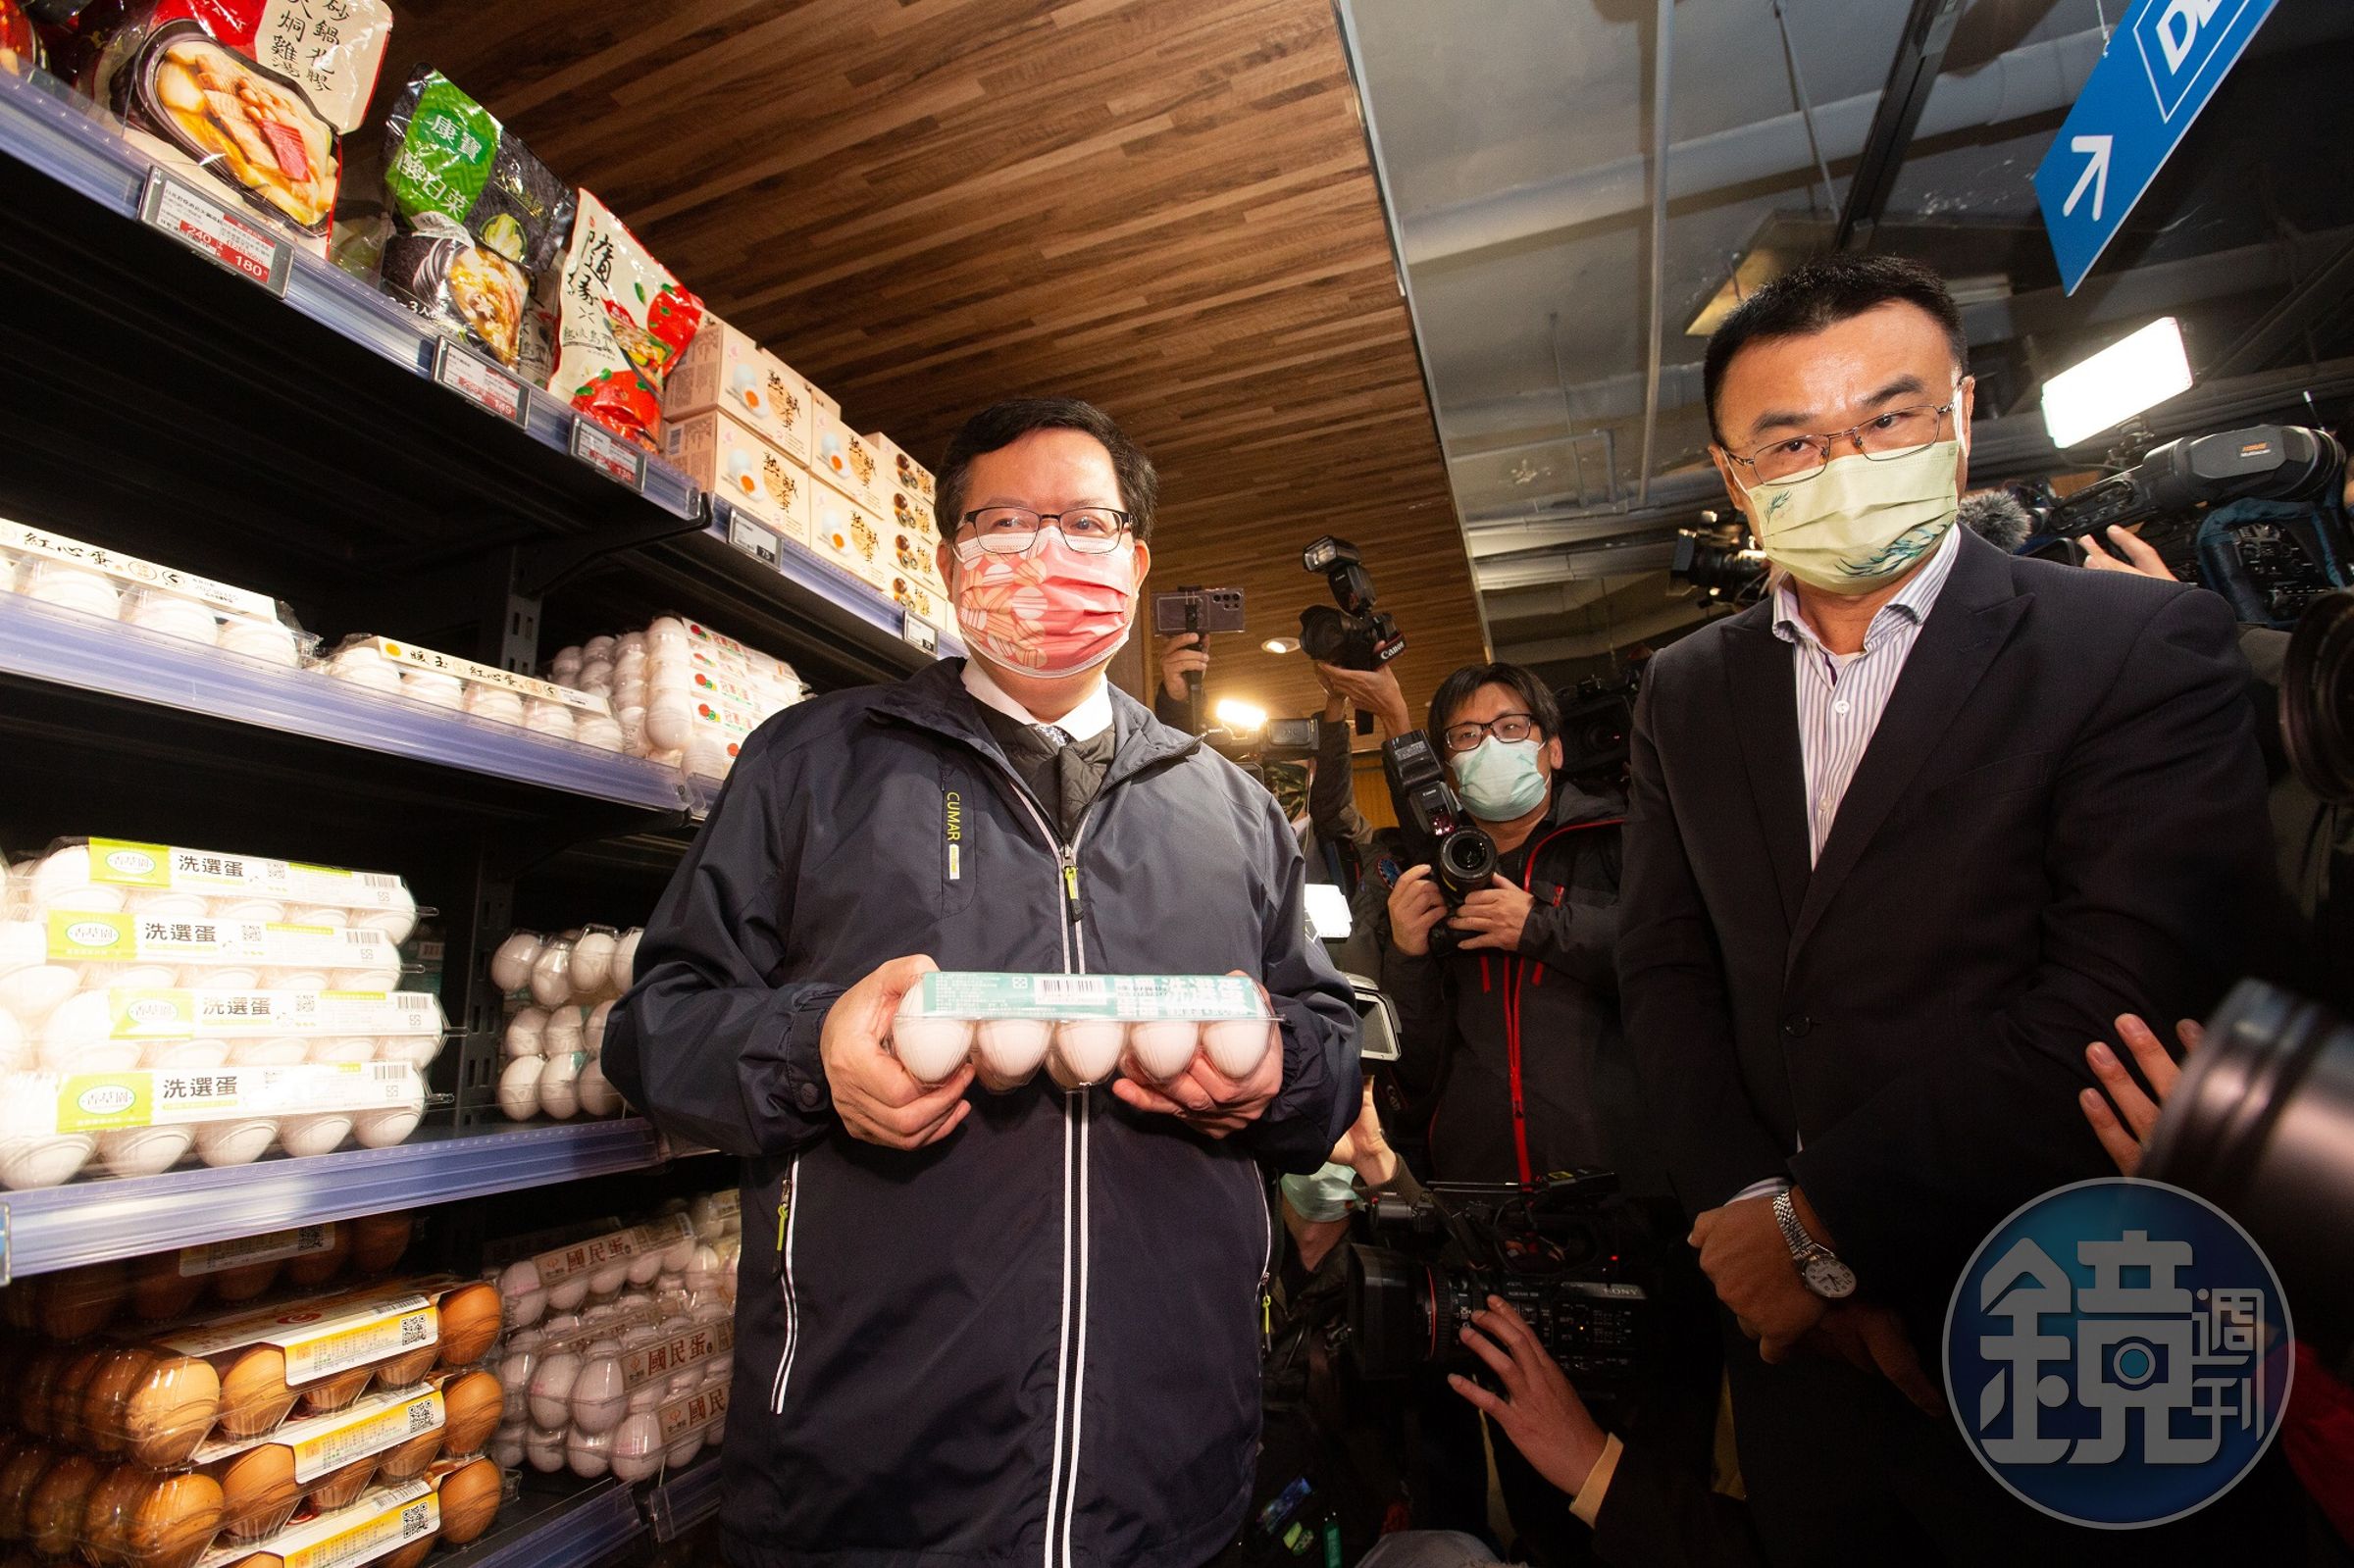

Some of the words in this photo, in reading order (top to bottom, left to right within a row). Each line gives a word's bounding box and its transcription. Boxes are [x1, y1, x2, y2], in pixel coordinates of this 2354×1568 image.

[431, 114, 483, 165] 康寶
[234, 255, 263, 277] 180
[1381, 641, 1406, 660] Canon
[947, 791, 961, 841] CUMAR
[178, 853, 244, 878] 洗選蛋
[144, 922, 217, 942] 洗選蛋
[202, 995, 272, 1016] 洗選蛋
[162, 1075, 238, 1099] 洗選蛋
[566, 1236, 625, 1273] 國民蛋
[647, 1332, 707, 1377] 國民蛋
